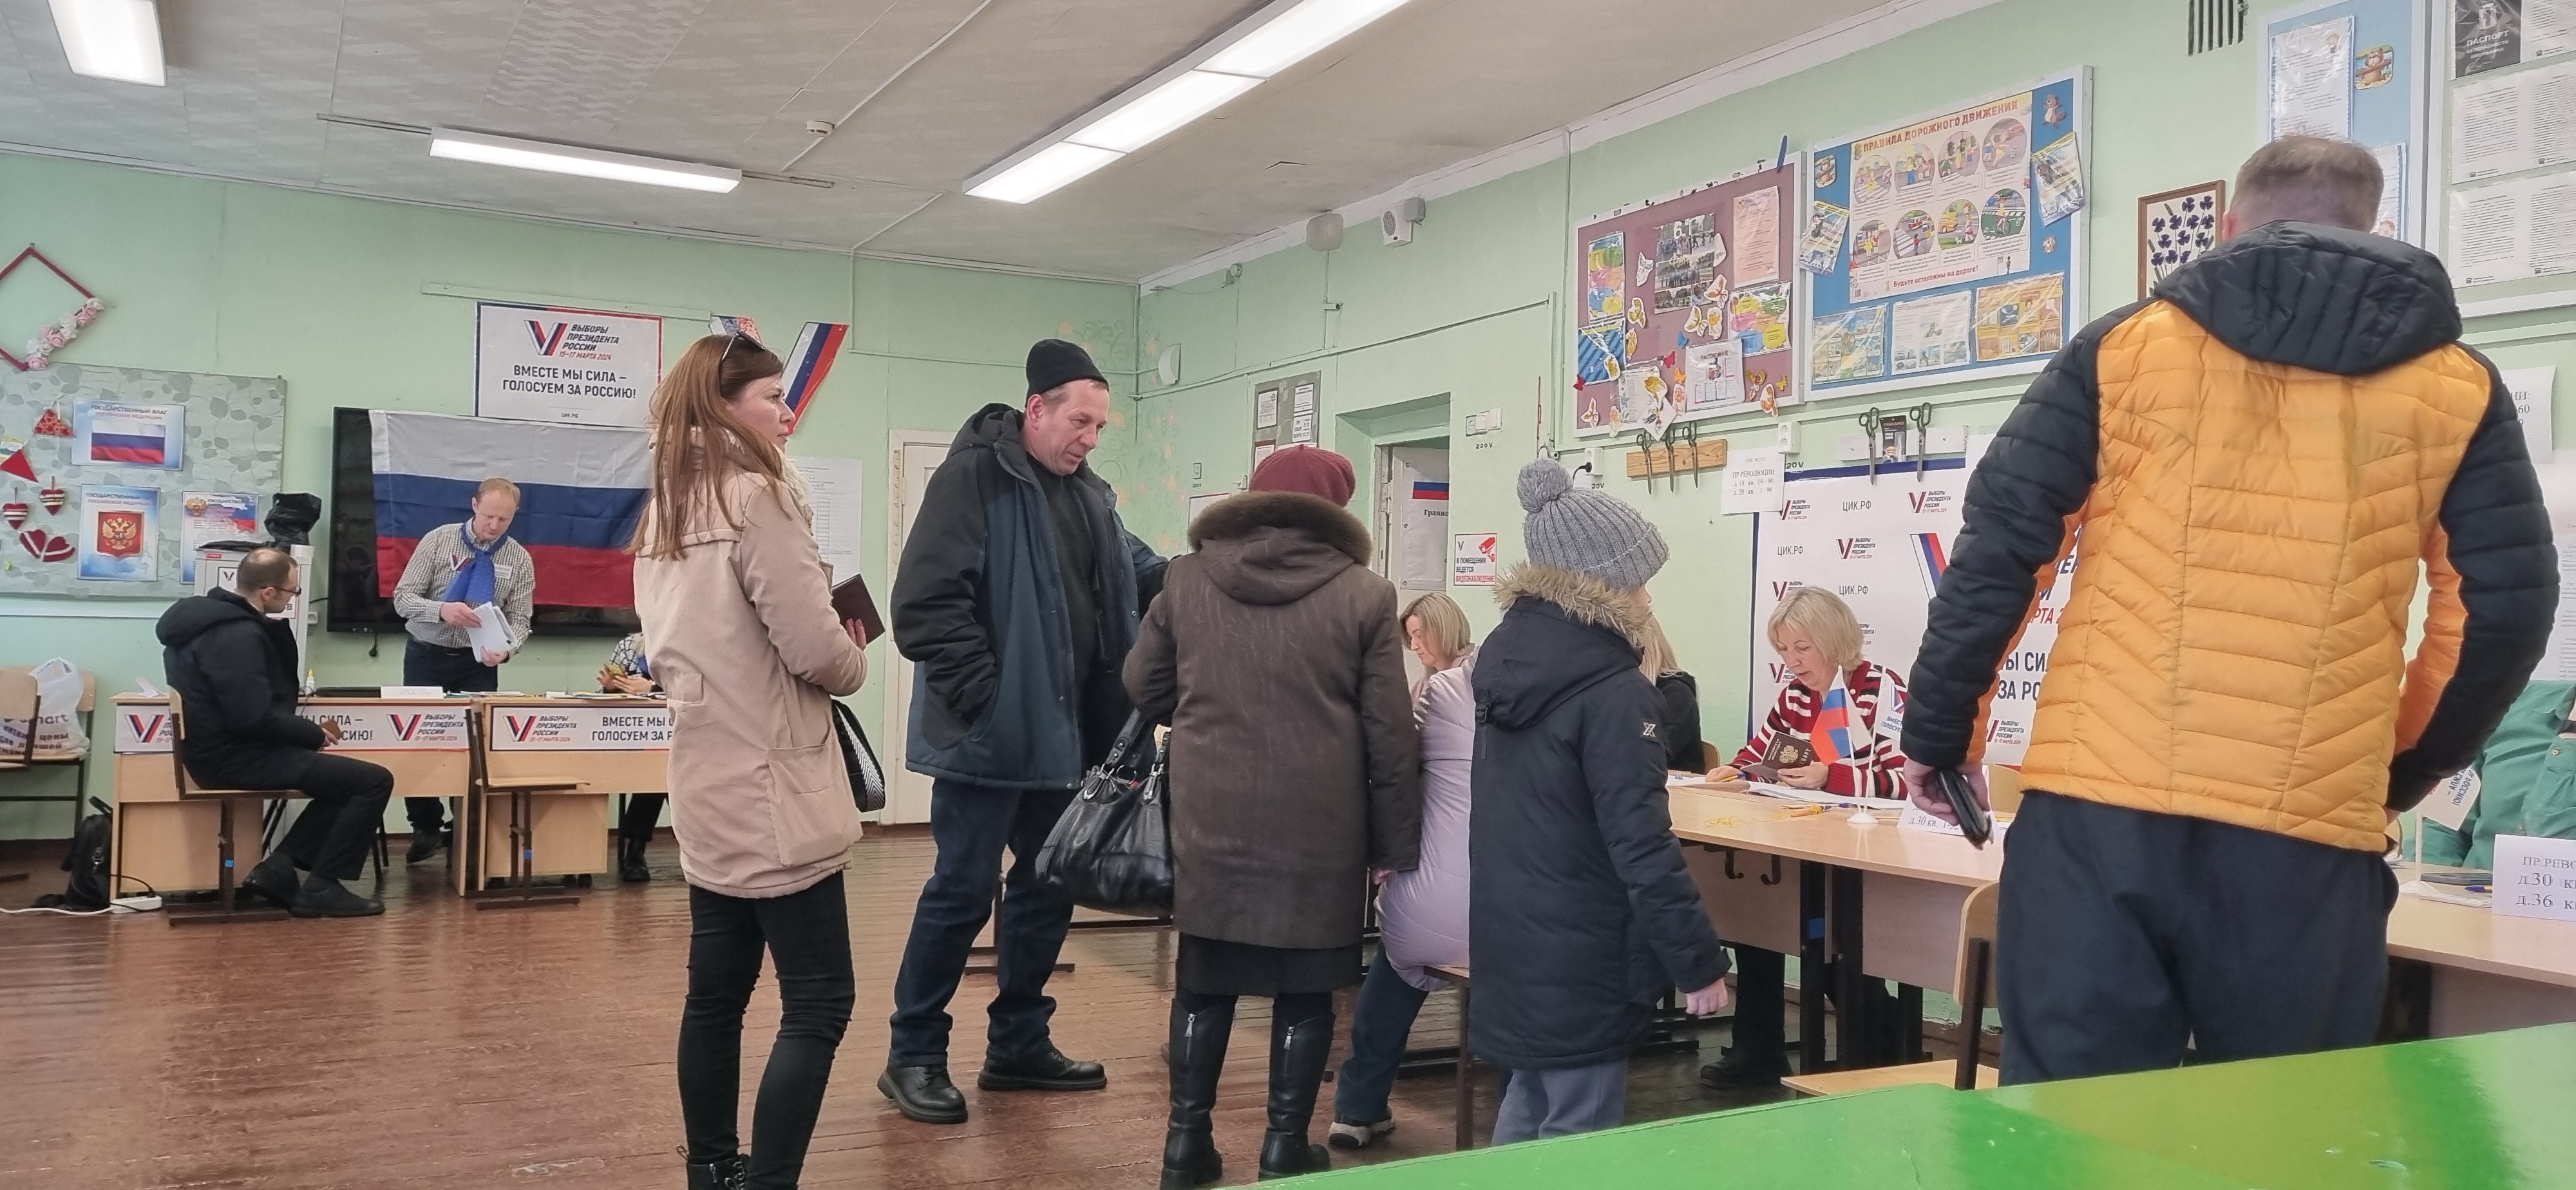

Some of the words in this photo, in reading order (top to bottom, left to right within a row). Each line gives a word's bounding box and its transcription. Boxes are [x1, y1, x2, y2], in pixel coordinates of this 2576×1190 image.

[2466, 30, 2510, 46] ПАСПОРТ
[1863, 133, 1902, 153] ПРАВИЛА
[1904, 117, 1960, 142] ДОРОЖНОГО
[1962, 100, 2018, 126] ДВИЖЕНИЯ
[1893, 279, 1914, 288] Будьте
[1915, 272, 1946, 283] осторожны
[1956, 265, 1978, 276] дороге!
[571, 324, 609, 334] ВЫБОРЫ
[566, 333, 619, 344] ПРЕЗИДЕНТА
[562, 342, 597, 351] РОССИИ
[514, 364, 559, 379] ВМЕСТЕ
[562, 369, 583, 380] МЫ
[585, 370, 616, 382] СИЛА
[503, 379, 564, 393] ГОЛОСУЕМ
[567, 384, 582, 395] ЗА
[584, 385, 636, 399] РОССИЮ!
[1842, 500, 1871, 511] ЦИК.РФ
[1777, 545, 1804, 556] ЦИК.РФ
[1839, 585, 1868, 596] ЦИК.РФ
[2031, 607, 2054, 624] РТА
[2024, 652, 2049, 672] СИ
[1997, 680, 2016, 699] ЗА
[602, 717, 644, 726] ВМЕСТЕ
[647, 717, 665, 726] МЫ
[1887, 715, 1902, 726] ВМЕСТ
[1881, 721, 1901, 732] ГОЛОСУЕ
[341, 730, 373, 740] СИЮ!
[592, 731, 647, 741] ГОЛОСУЕМ
[651, 730, 664, 741] ЗА
[2518, 873, 2553, 886] д.30
[2515, 893, 2553, 907] д.36
